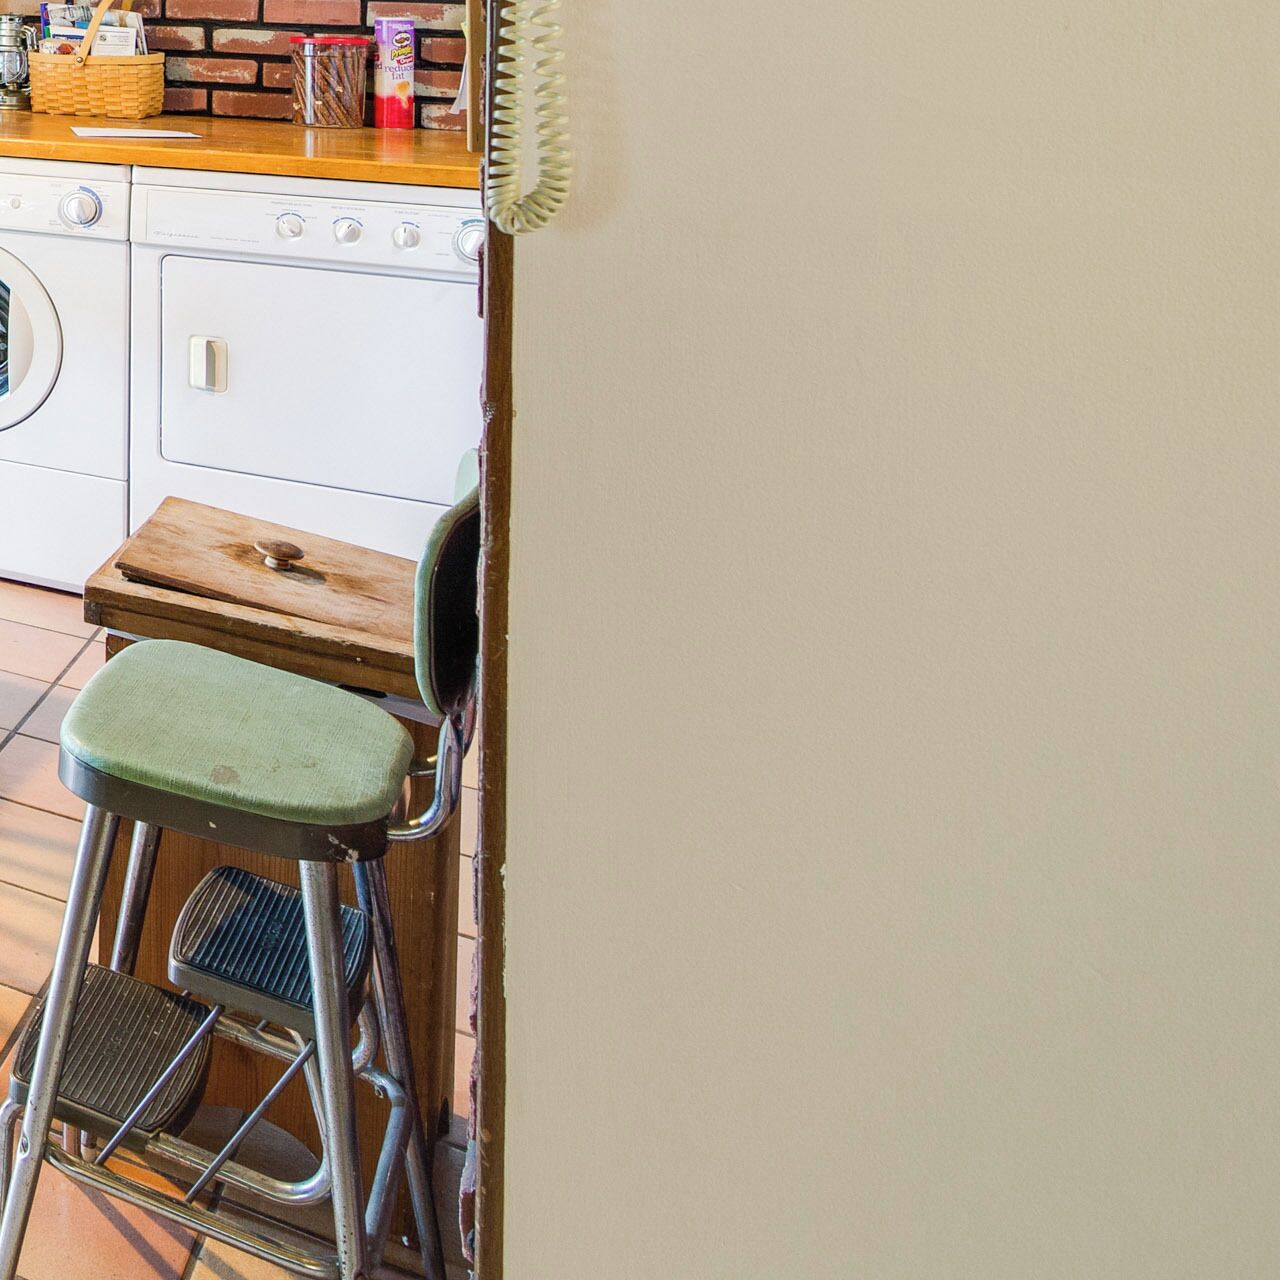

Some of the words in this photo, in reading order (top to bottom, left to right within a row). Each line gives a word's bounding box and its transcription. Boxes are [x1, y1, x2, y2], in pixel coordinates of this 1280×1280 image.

[391, 46, 413, 60] Pringle
[384, 64, 414, 72] reduce
[391, 72, 405, 80] fat
